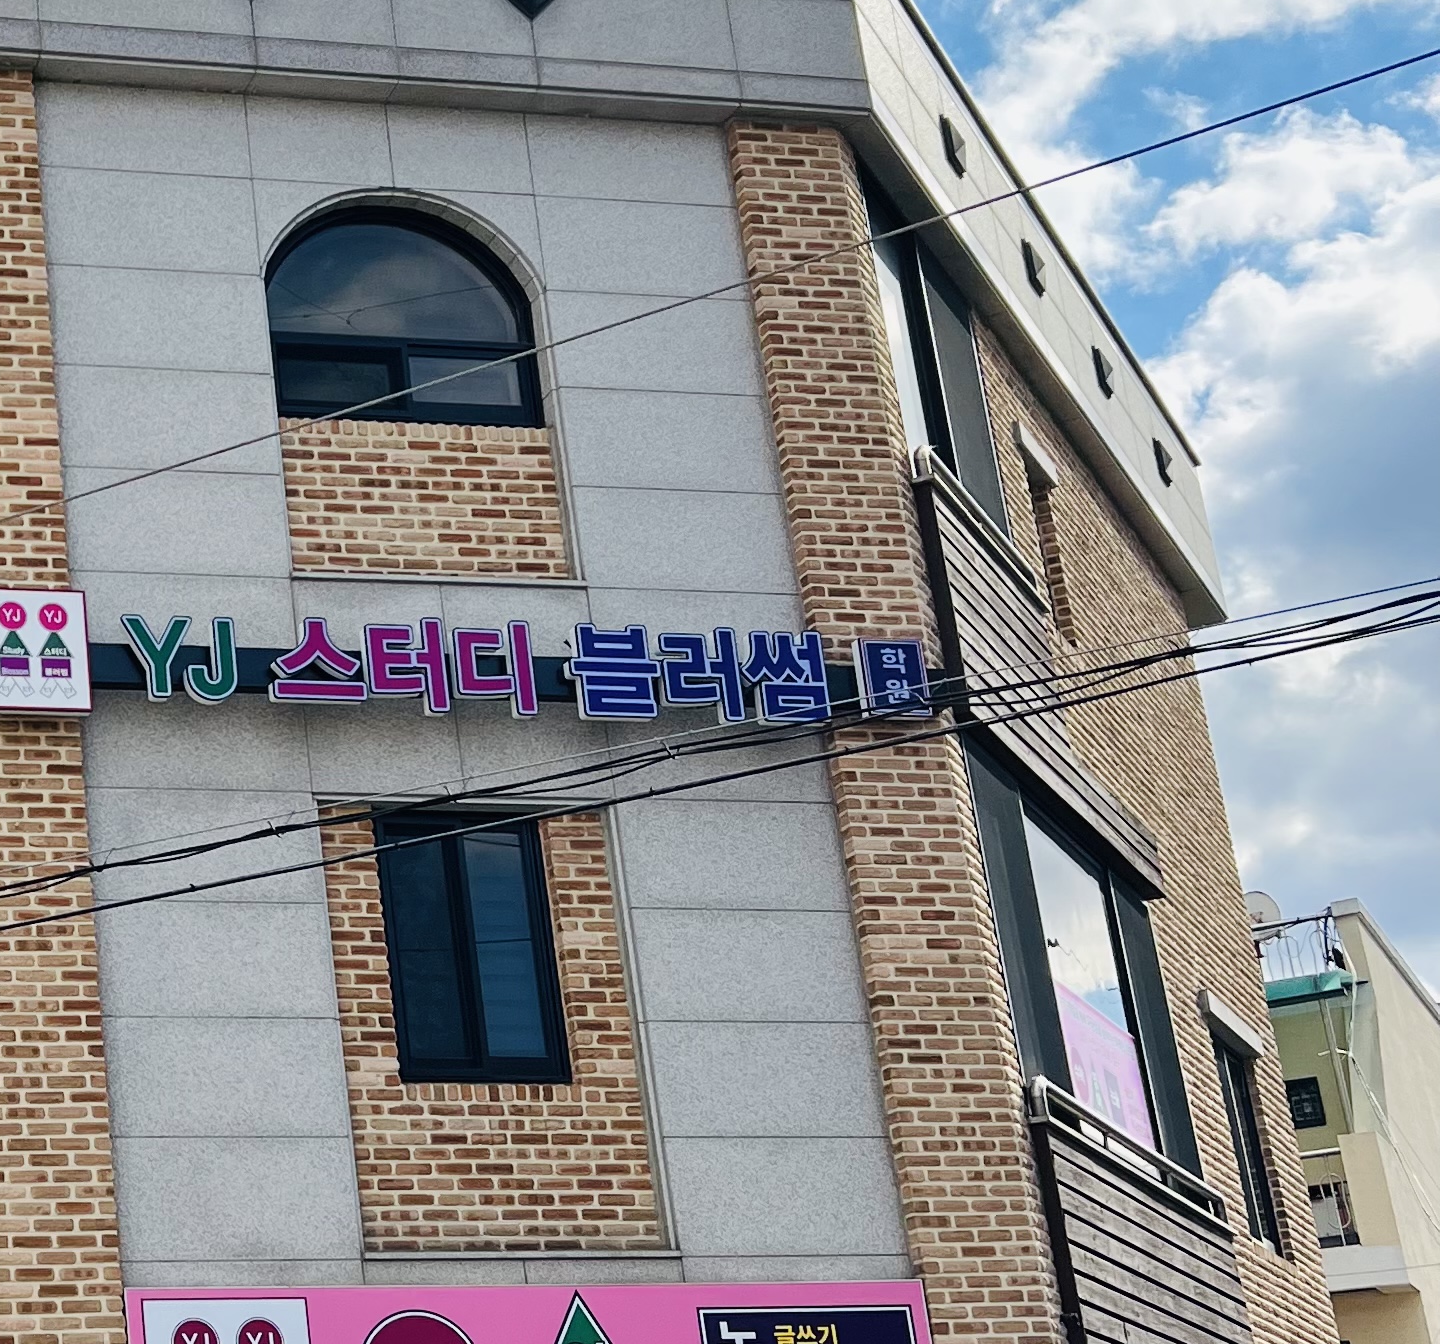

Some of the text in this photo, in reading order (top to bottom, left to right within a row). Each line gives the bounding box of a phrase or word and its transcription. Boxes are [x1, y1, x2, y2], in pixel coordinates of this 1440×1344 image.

[1, 607, 22, 622] YJ
[43, 609, 63, 624] YJ
[120, 614, 832, 725] YJ 스터디 블러썸
[880, 647, 910, 705] 학원
